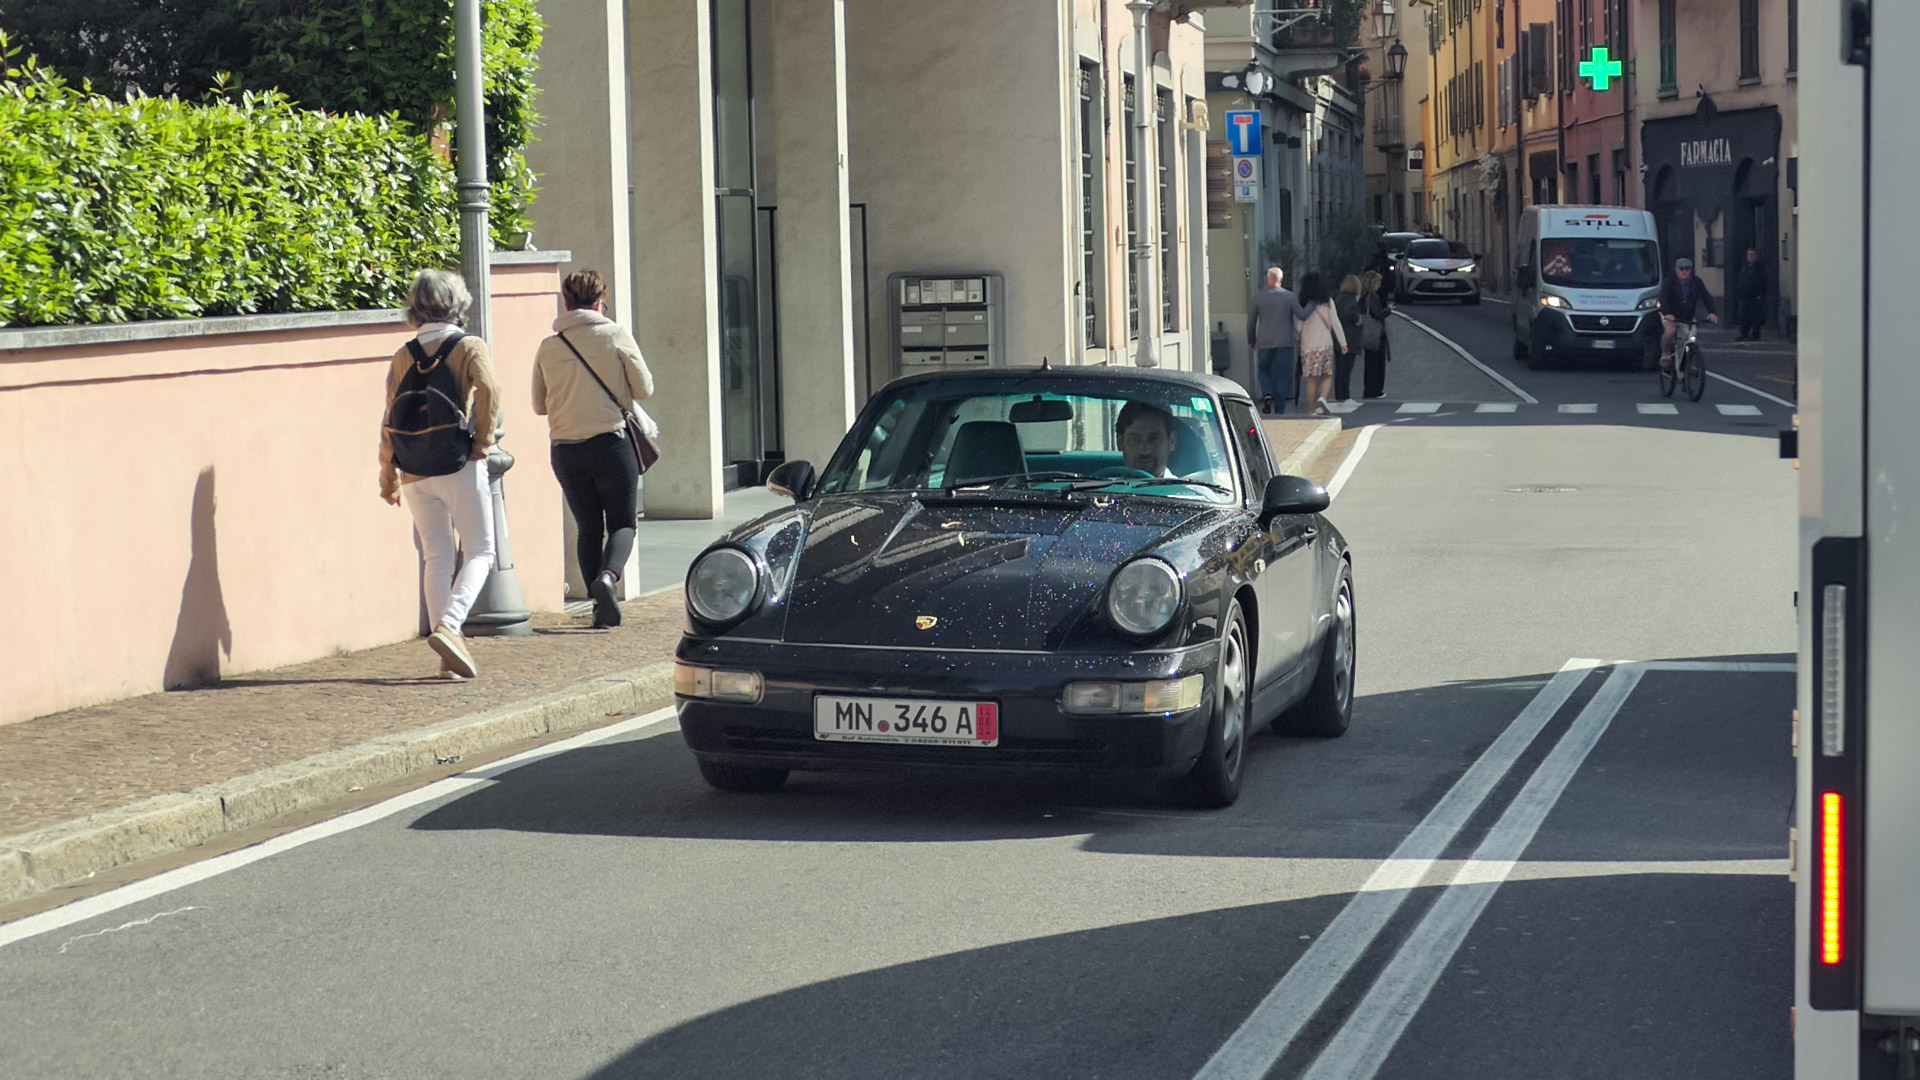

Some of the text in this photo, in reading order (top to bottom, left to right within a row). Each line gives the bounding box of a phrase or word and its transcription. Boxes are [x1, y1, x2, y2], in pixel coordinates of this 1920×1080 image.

[1680, 138, 1733, 166] FARMACIA
[1565, 218, 1631, 229] STILL
[835, 702, 973, 735] MN 346 A
